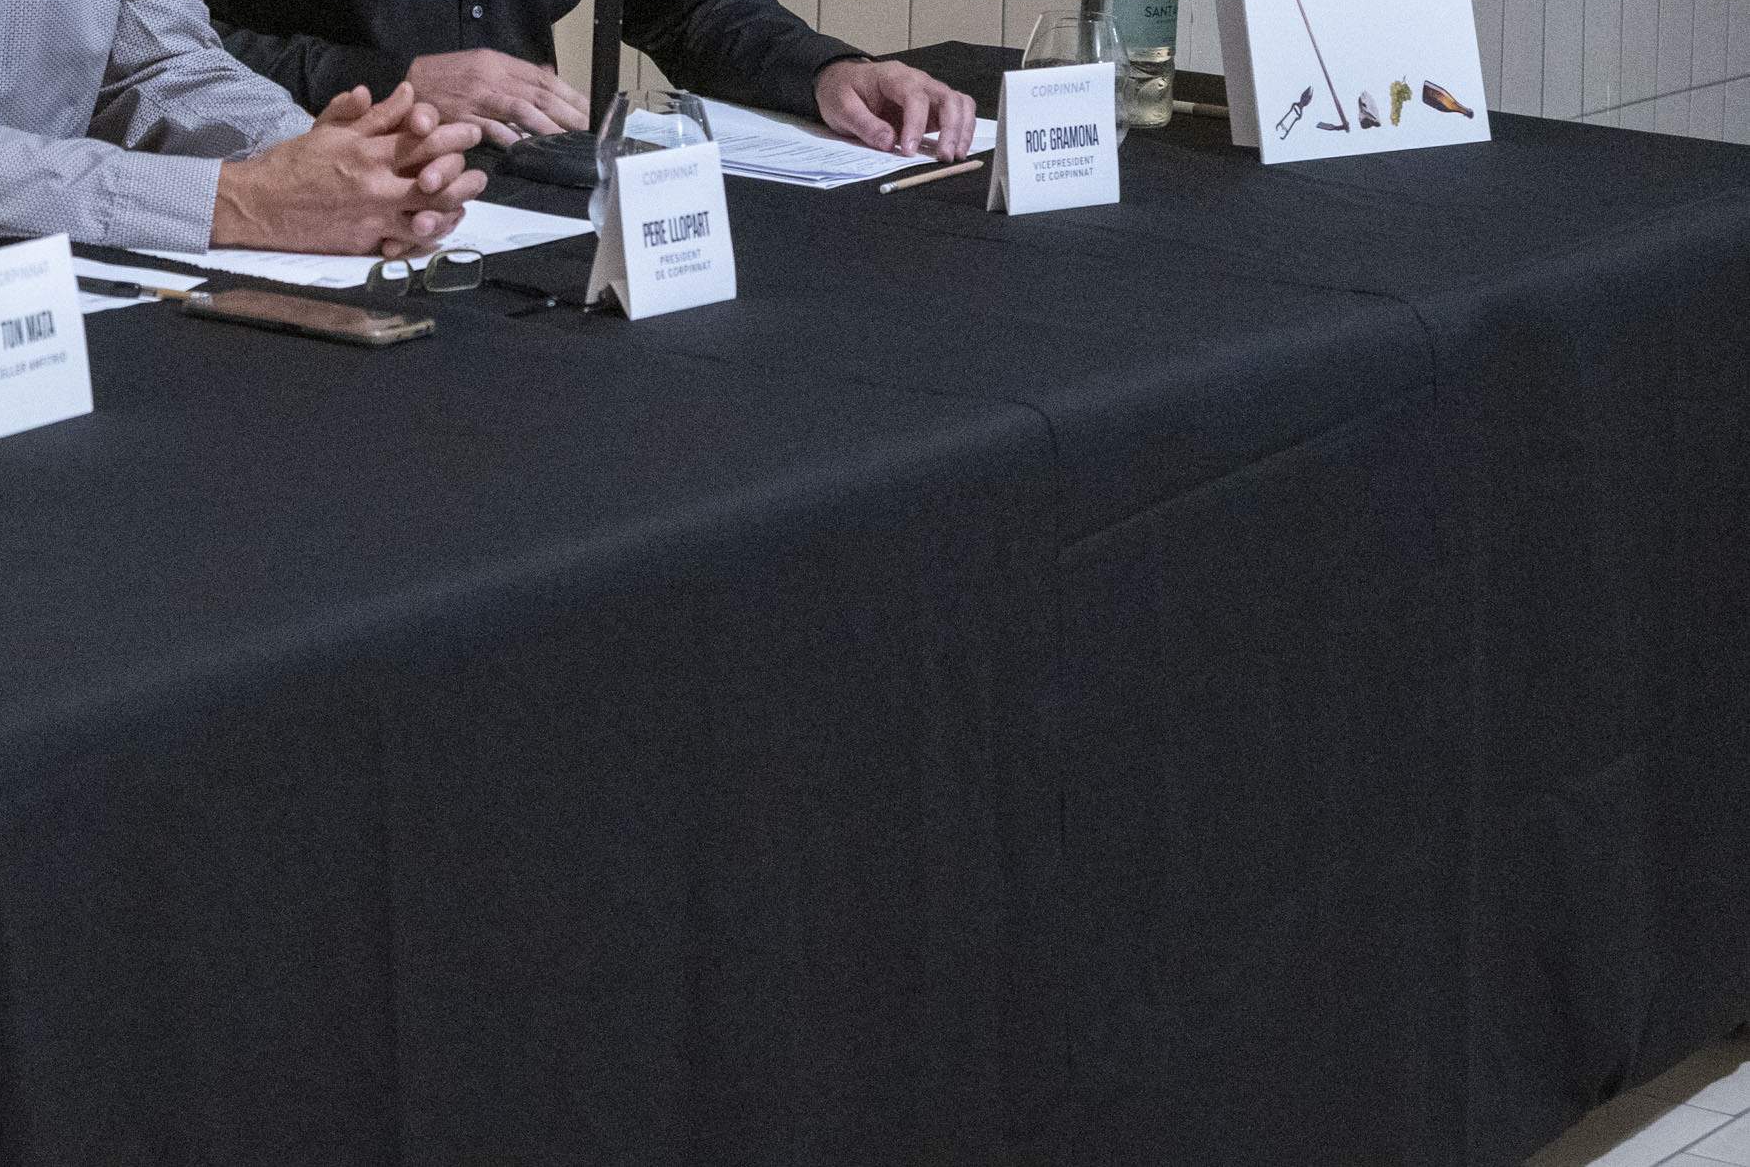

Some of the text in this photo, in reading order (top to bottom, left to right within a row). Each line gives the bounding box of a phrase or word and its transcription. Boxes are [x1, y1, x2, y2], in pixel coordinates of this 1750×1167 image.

[1031, 80, 1091, 98] CORPINNAT
[1025, 123, 1100, 153] ROC GRAMONA
[1033, 155, 1094, 170] VICEPRESIDENT
[642, 163, 699, 186] CORPINNAT
[1035, 167, 1093, 182] DE CORPINNAT
[642, 210, 711, 248] PERE LLOPART
[659, 249, 702, 267] PRESIDENT
[655, 260, 711, 281] DE CORPINNAT
[0, 309, 57, 351] TON MATA
